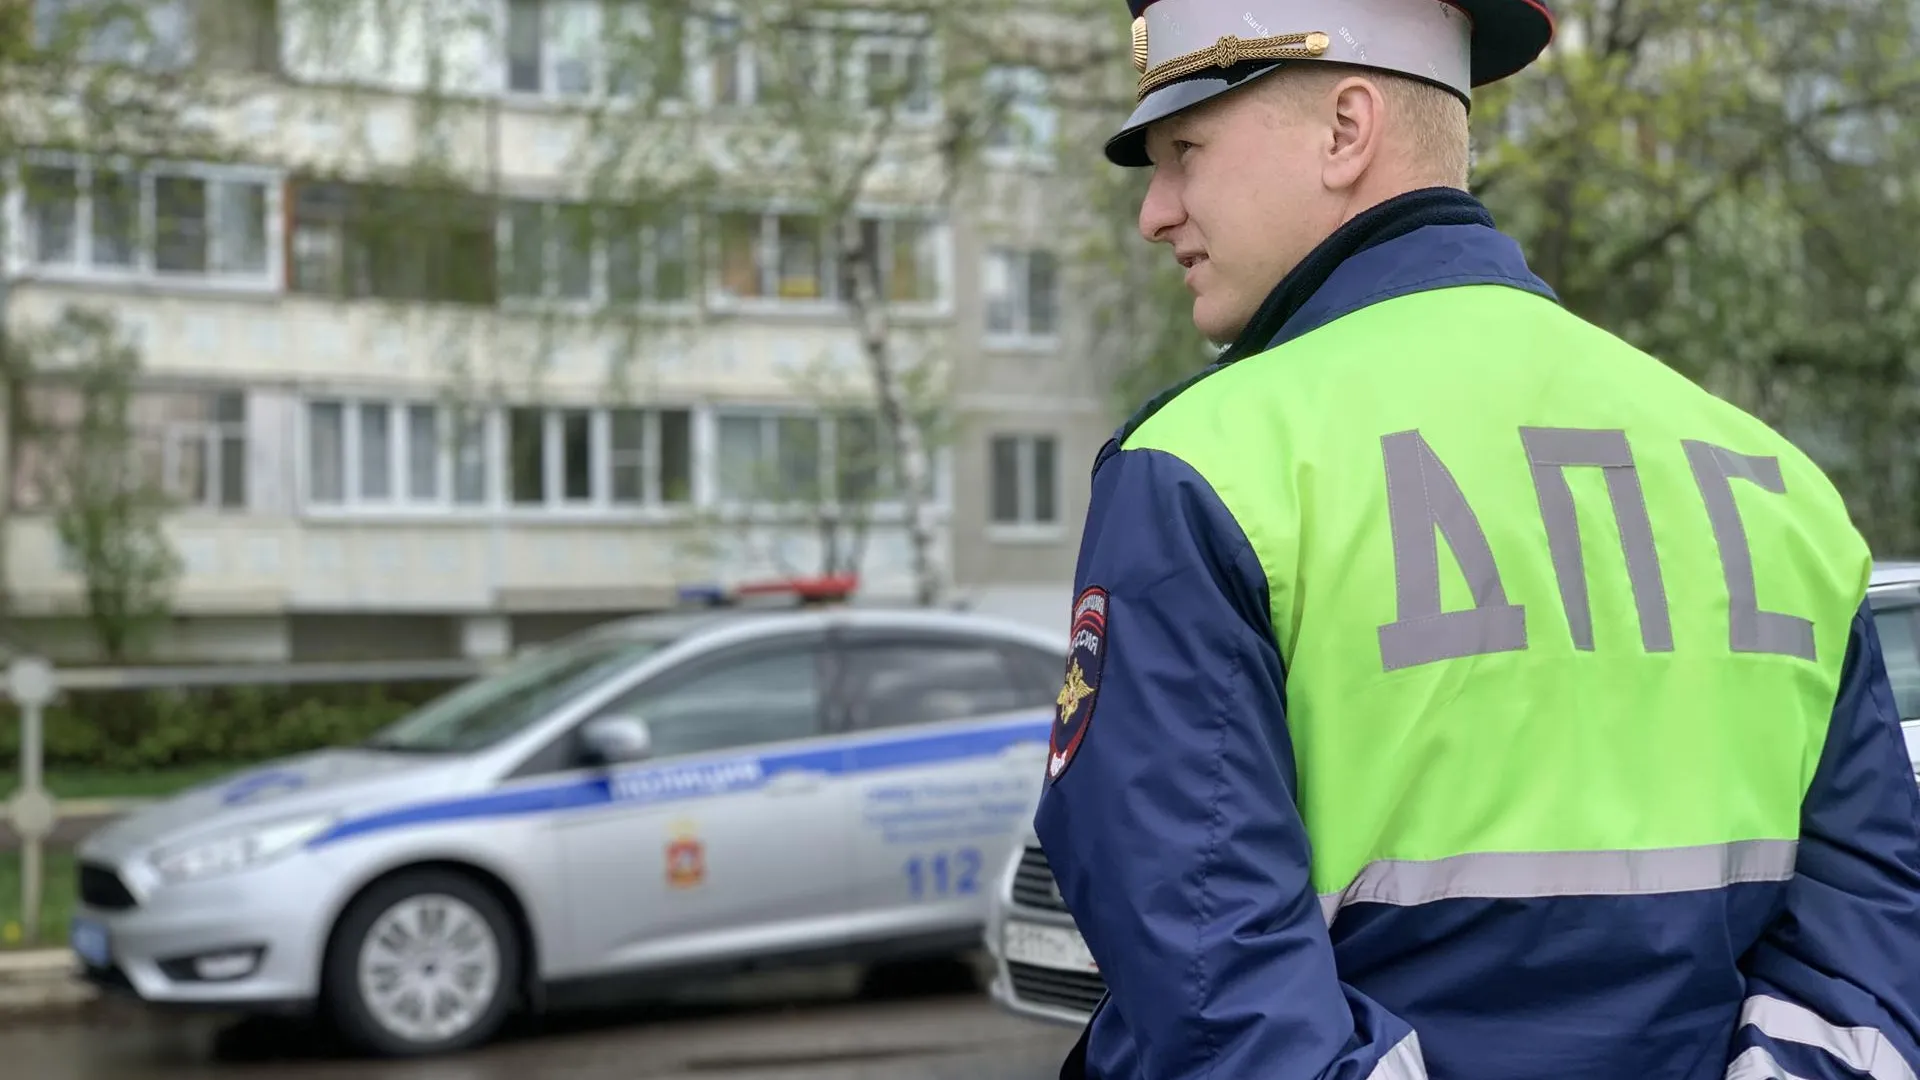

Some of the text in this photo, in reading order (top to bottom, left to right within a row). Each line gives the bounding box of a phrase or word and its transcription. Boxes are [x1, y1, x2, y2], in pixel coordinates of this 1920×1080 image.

[1243, 11, 1270, 38] StarLi
[1377, 426, 1817, 672] ДПС
[1068, 629, 1098, 664] ССИЯ
[905, 846, 983, 899] 112
